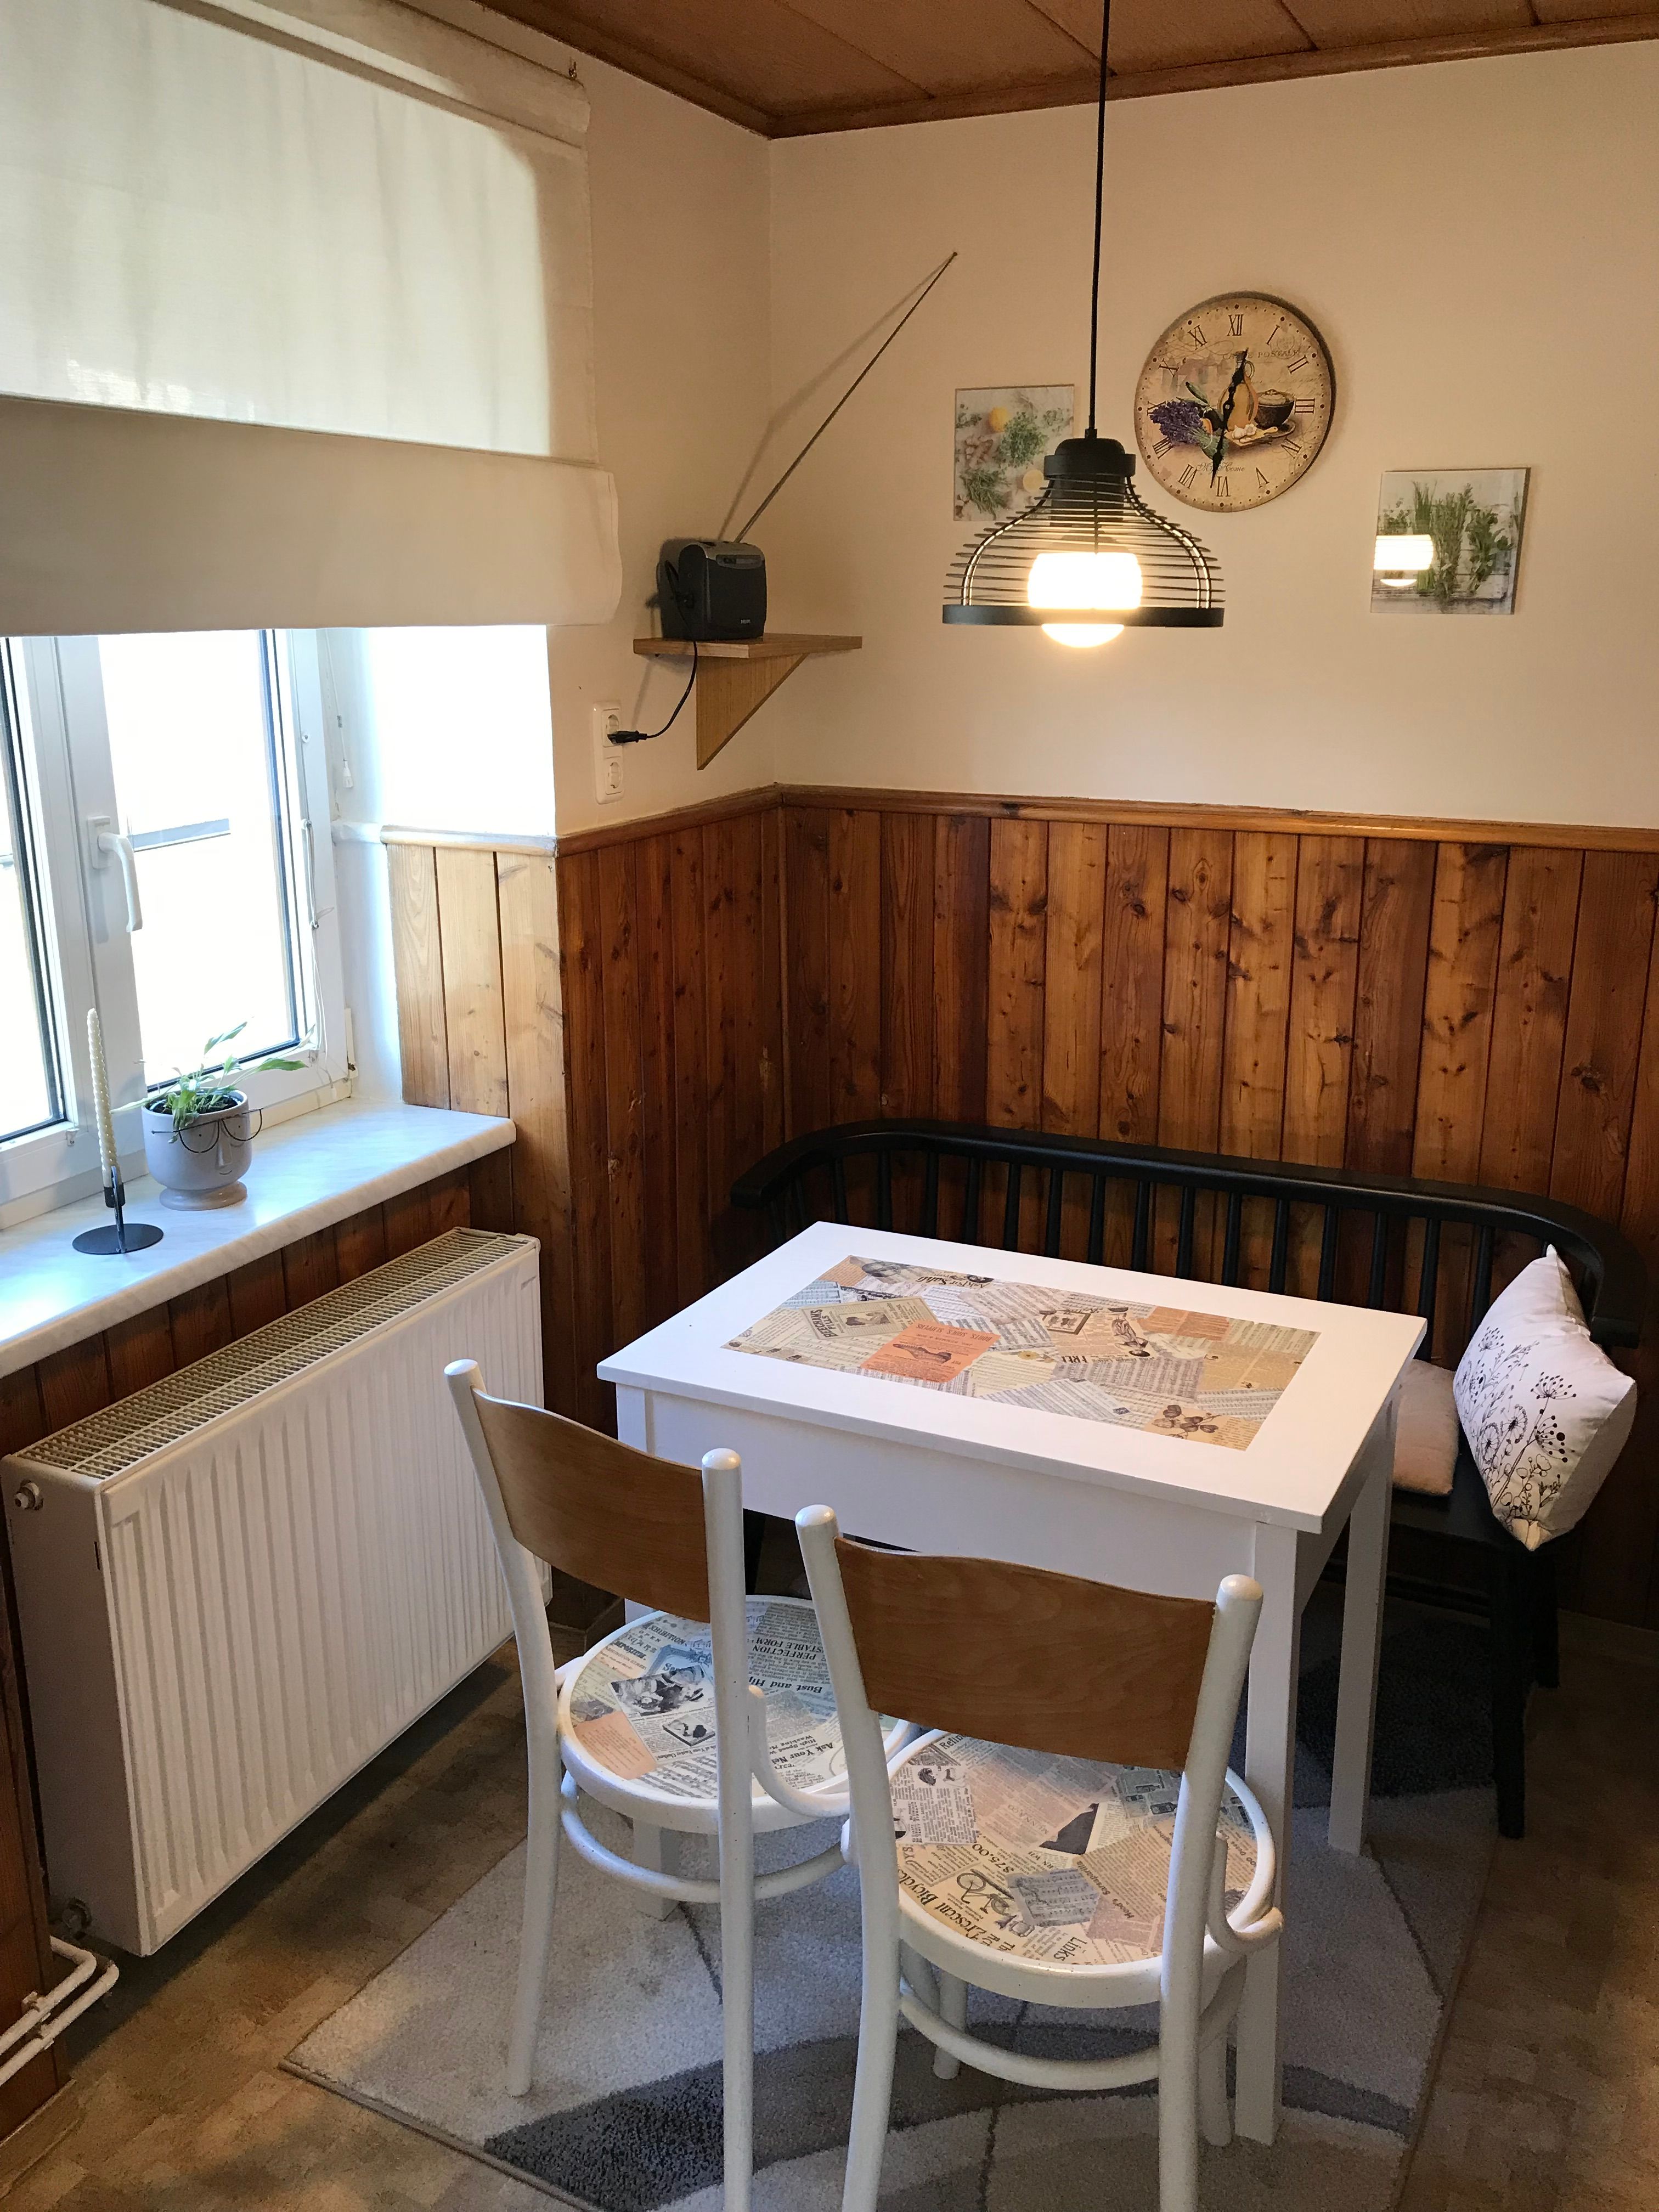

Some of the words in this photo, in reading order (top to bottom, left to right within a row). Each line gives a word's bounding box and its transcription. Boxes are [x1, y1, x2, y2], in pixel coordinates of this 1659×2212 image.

[1227, 314, 1244, 336] XII
[1188, 325, 1207, 350] XI
[1158, 358, 1180, 377] X
[1287, 354, 1309, 374] II
[1147, 400, 1166, 416] X
[1295, 398, 1316, 414] III
[1281, 437, 1302, 459] IV
[1177, 464, 1198, 489] VII
[1216, 476, 1231, 497] VI
[1256, 467, 1269, 488] V
[752, 1644, 816, 1660] PERFECTION
[755, 1637, 783, 1647] FORM
[786, 1641, 824, 1653] STABLE
[795, 1684, 822, 1693] Bust
[789, 1748, 814, 1759] Your
[815, 1742, 833, 1752] Ask
[1076, 1860, 1111, 1896] Sarsaparilla
[1110, 1897, 1135, 1920] Hood's
[937, 1900, 988, 1940] Crescent
[1053, 1936, 1087, 1959] Links
